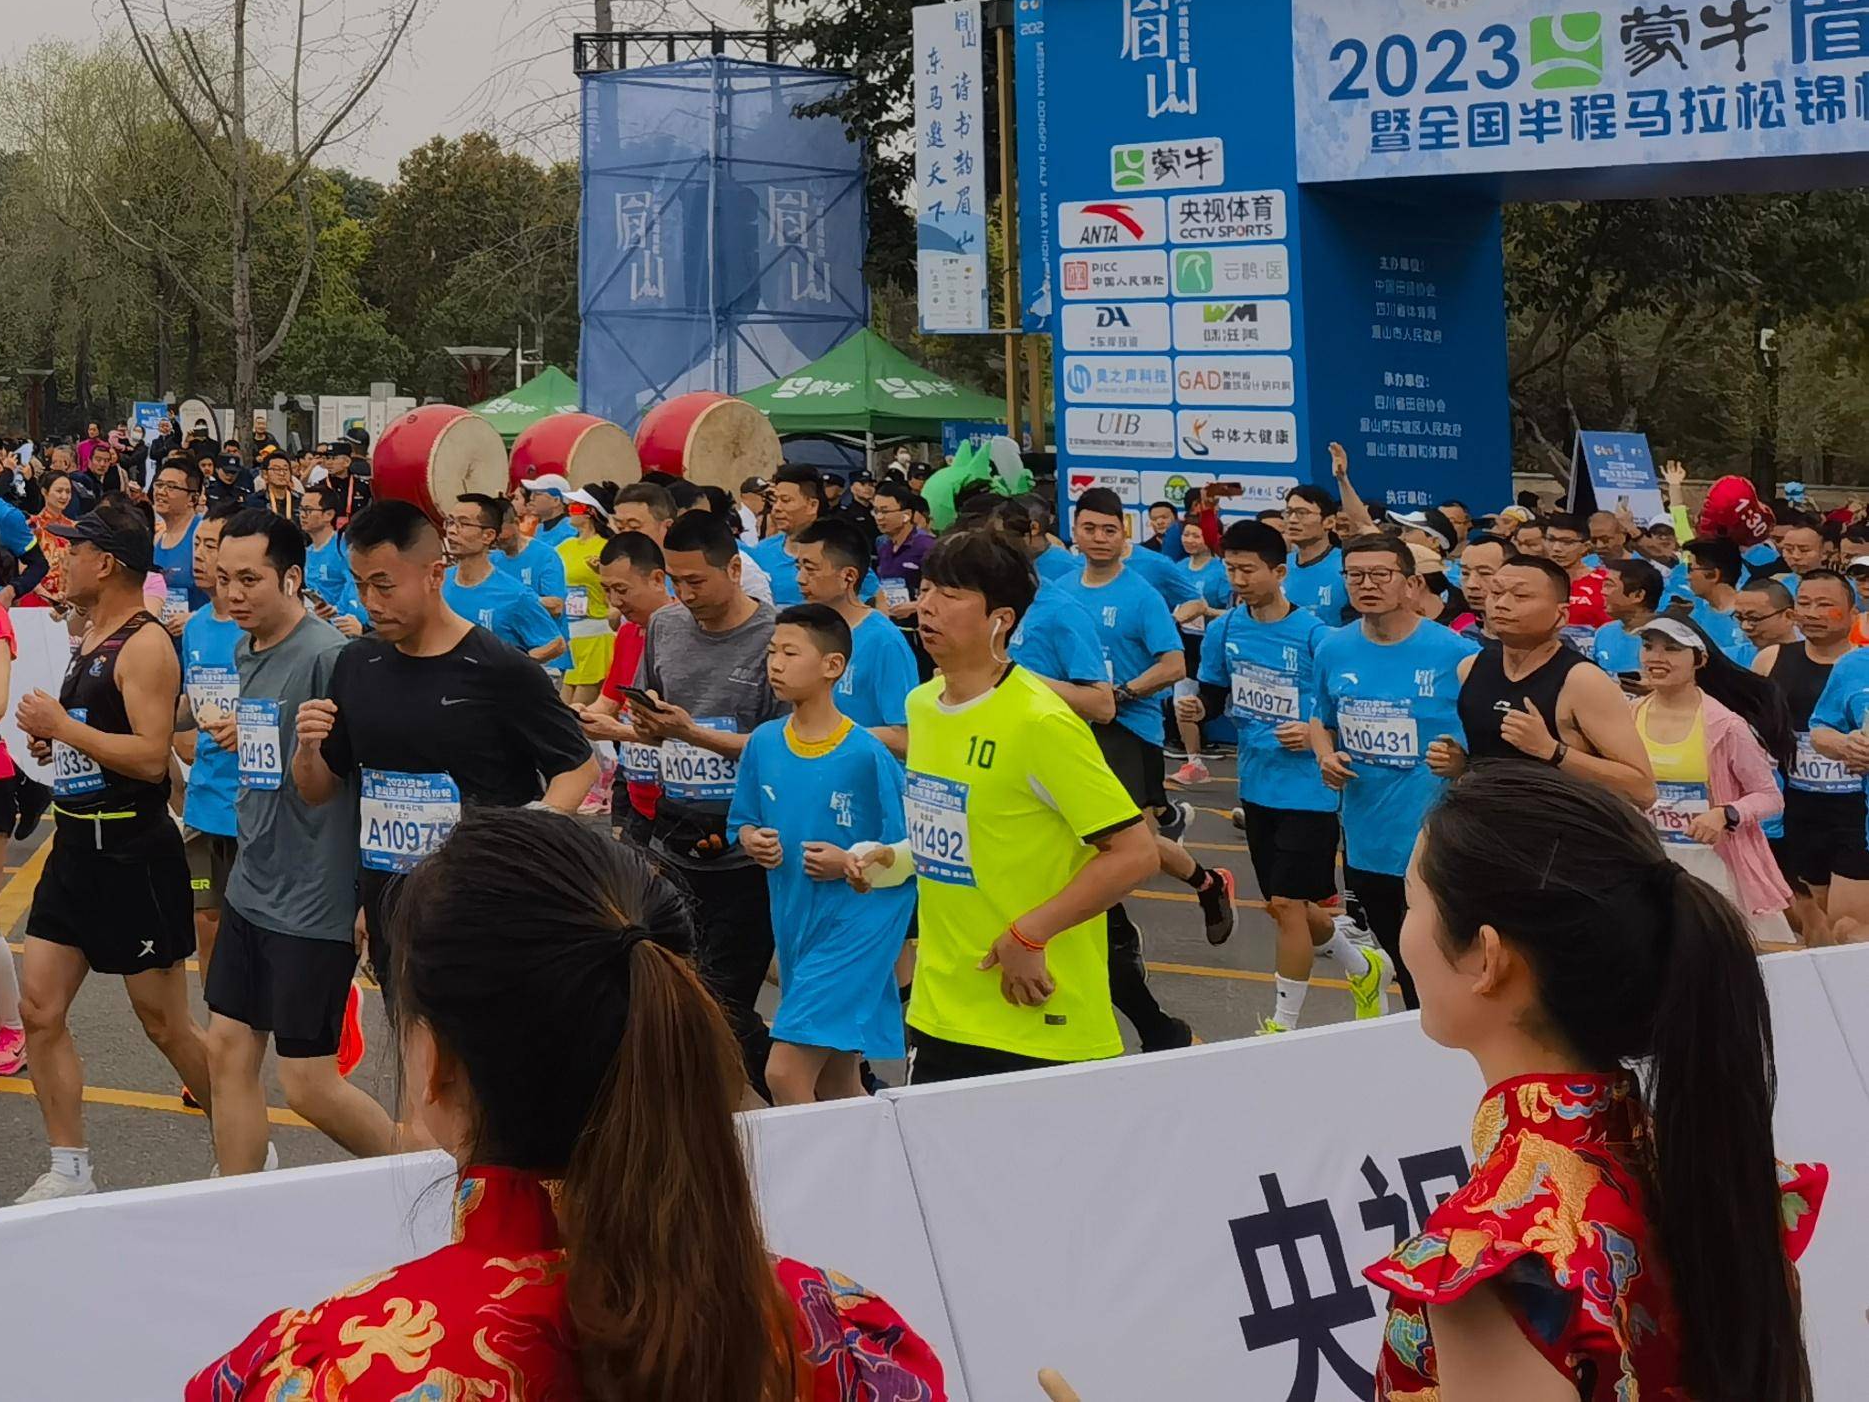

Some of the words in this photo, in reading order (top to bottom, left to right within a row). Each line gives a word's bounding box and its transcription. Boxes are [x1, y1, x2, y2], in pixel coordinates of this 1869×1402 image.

[1329, 24, 1521, 101] 2023
[1152, 146, 1213, 181] 蒙牛
[1179, 195, 1274, 224] 央视体育
[1079, 225, 1118, 245] ANTA
[1180, 227, 1214, 239] CCTV
[1218, 224, 1273, 238] SPORTS
[1092, 262, 1117, 272] PICC
[1092, 275, 1164, 286] 中国人民保险
[1178, 370, 1221, 391] GAD
[1097, 413, 1141, 435] UIB
[1211, 428, 1290, 445] 中体大健康
[1733, 498, 1768, 538] 1:30
[1237, 686, 1294, 715] A10977
[1344, 725, 1412, 754] A10431
[966, 735, 996, 769] 10
[665, 757, 736, 781] A10433
